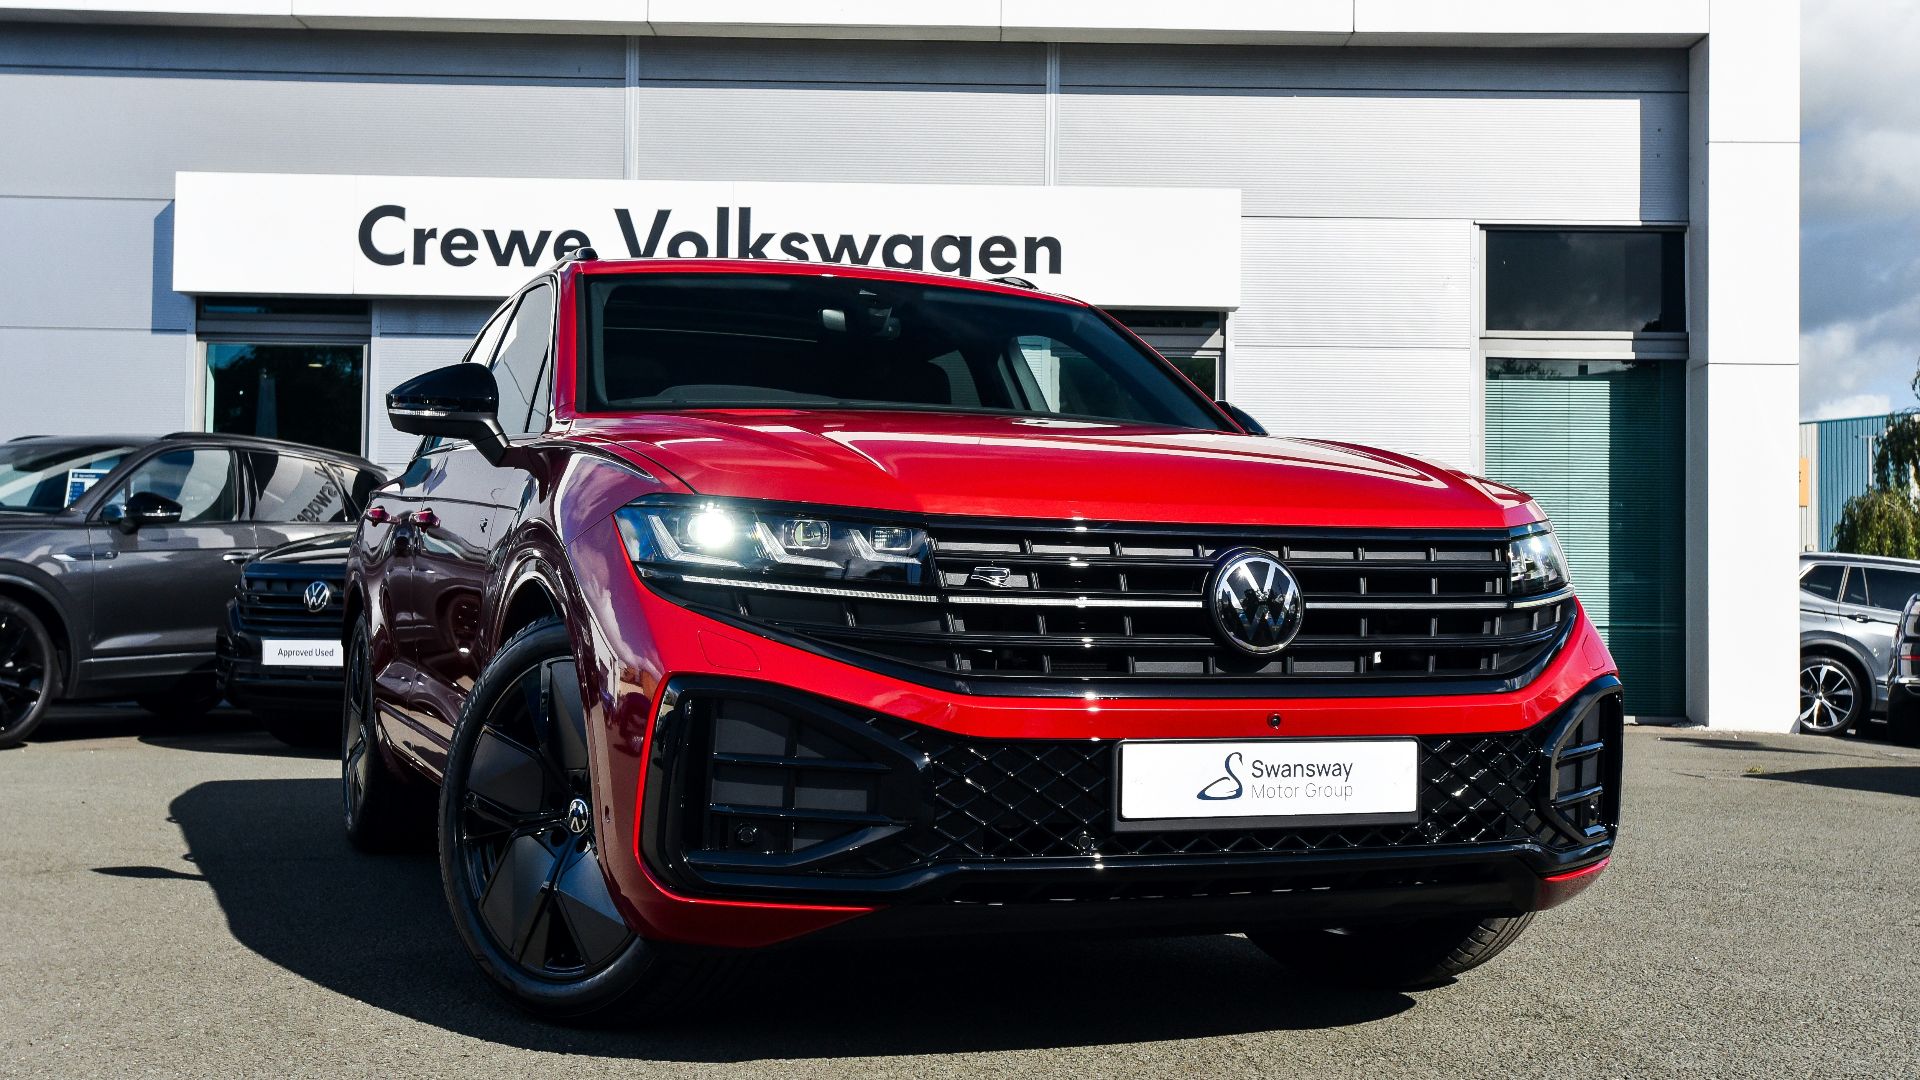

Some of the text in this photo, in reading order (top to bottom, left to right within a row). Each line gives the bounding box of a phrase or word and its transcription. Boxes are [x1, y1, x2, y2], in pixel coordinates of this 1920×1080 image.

[358, 204, 1062, 277] Crewe Volkswagen
[278, 647, 334, 658] Approved Used
[1251, 759, 1353, 783] Swansway
[1251, 782, 1353, 801] Motor Group
